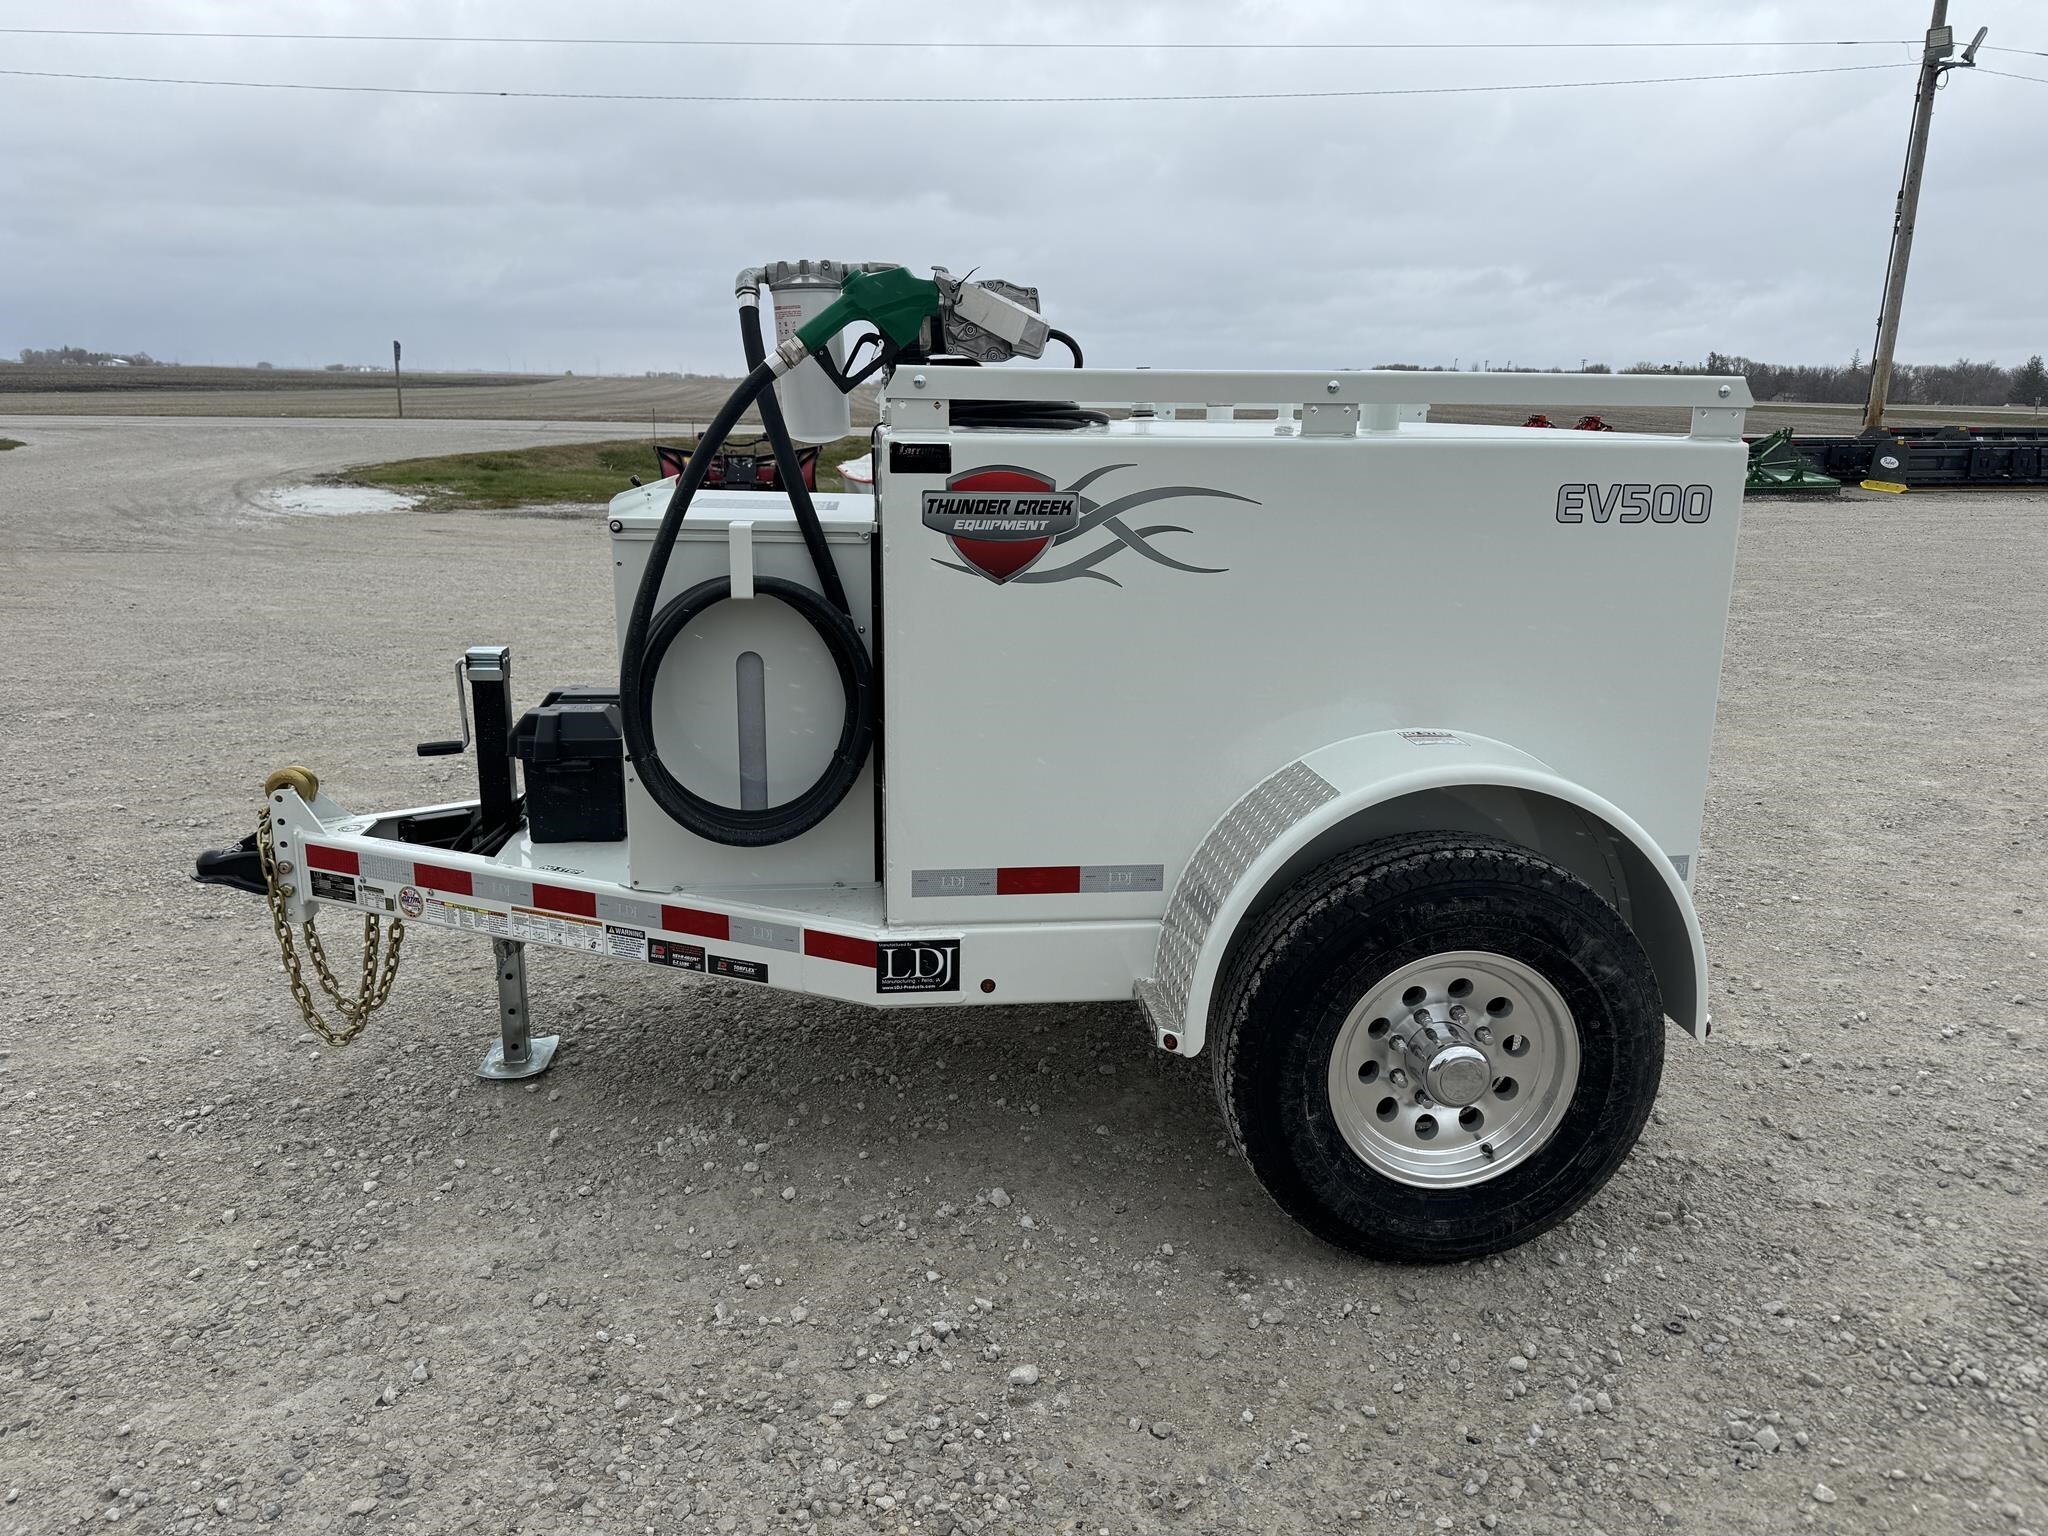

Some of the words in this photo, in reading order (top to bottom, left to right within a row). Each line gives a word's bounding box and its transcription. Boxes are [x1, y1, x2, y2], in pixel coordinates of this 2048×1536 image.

[927, 499, 1010, 515] THUNDER
[1014, 499, 1074, 516] CREEK
[1555, 483, 1713, 523] EV500
[953, 519, 1049, 532] EQUIPMENT
[941, 875, 966, 890] LDJ
[1108, 871, 1133, 885] LDJ
[615, 927, 643, 938] WARNING
[752, 926, 774, 942] LDJ
[882, 947, 958, 987] LDJ
